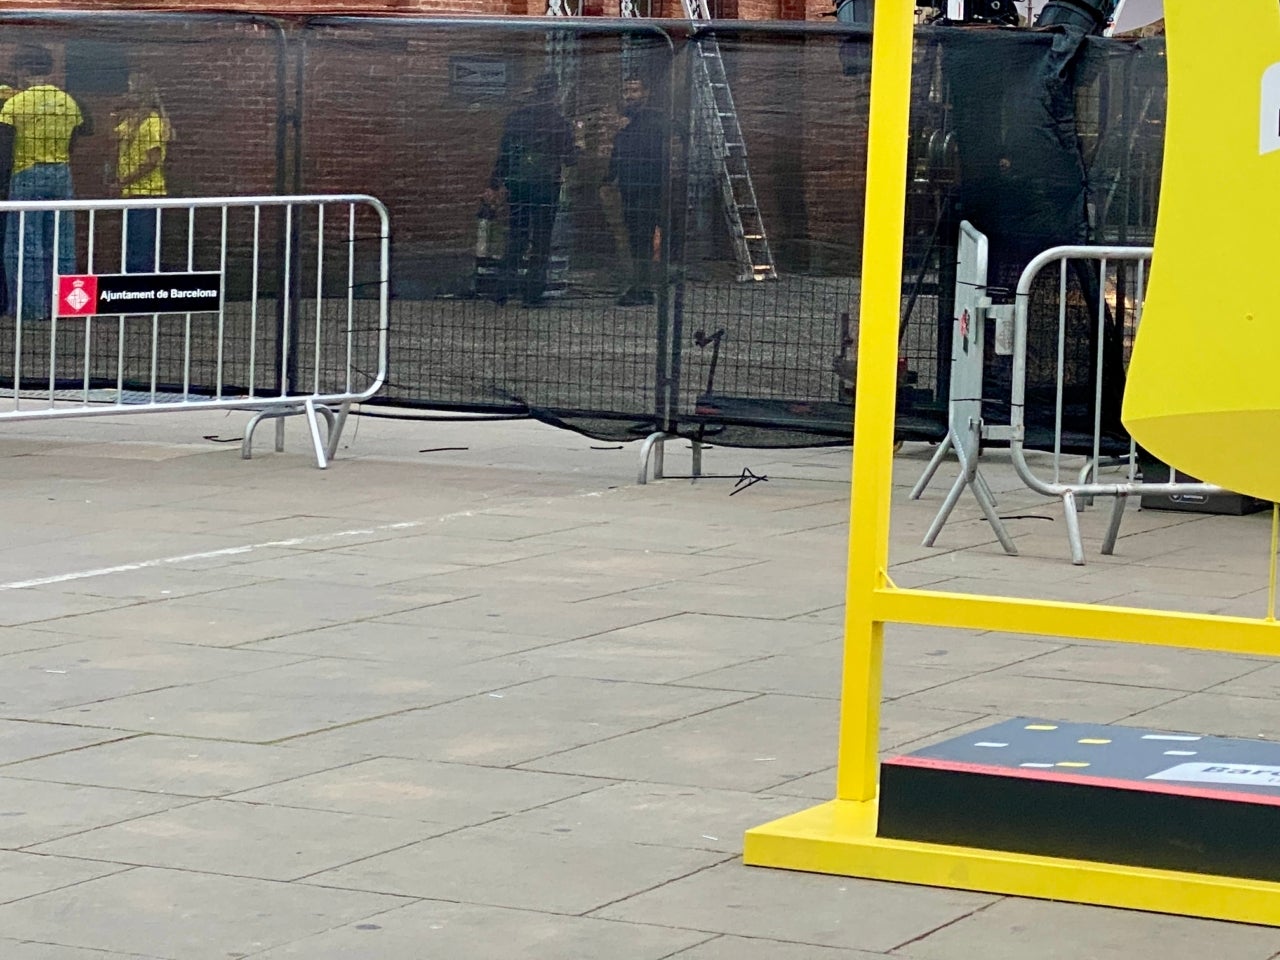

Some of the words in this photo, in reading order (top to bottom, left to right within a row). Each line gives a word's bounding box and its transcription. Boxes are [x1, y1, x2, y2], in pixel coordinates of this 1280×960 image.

[100, 290, 155, 302] Ajuntament
[157, 289, 168, 299] de
[170, 288, 217, 299] Barcelona
